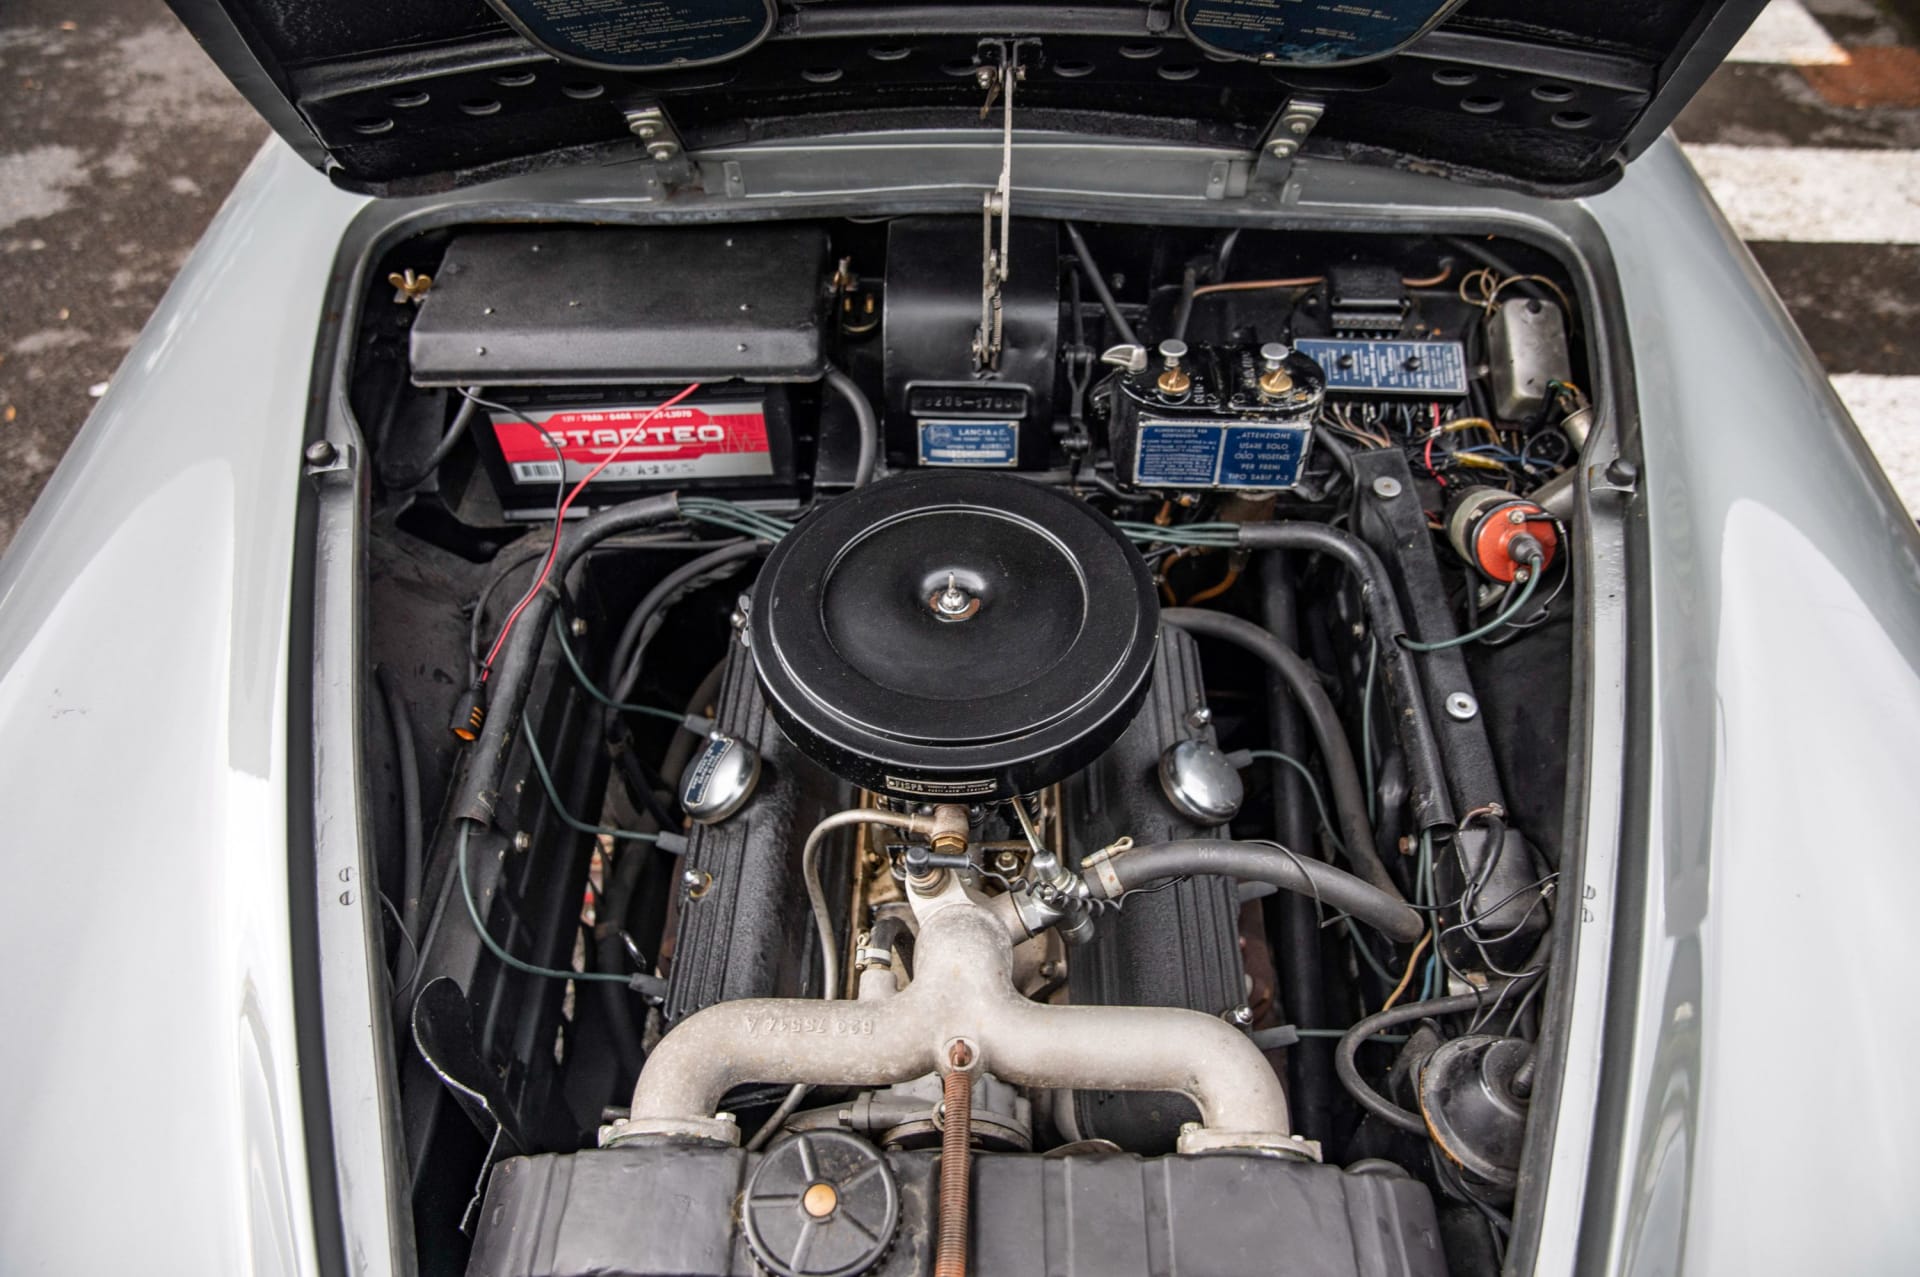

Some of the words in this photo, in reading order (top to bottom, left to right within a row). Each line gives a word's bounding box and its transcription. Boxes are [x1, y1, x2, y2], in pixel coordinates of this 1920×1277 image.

[540, 424, 725, 448] STARTEO
[958, 428, 992, 437] LANCIA
[895, 780, 924, 791] FISPA
